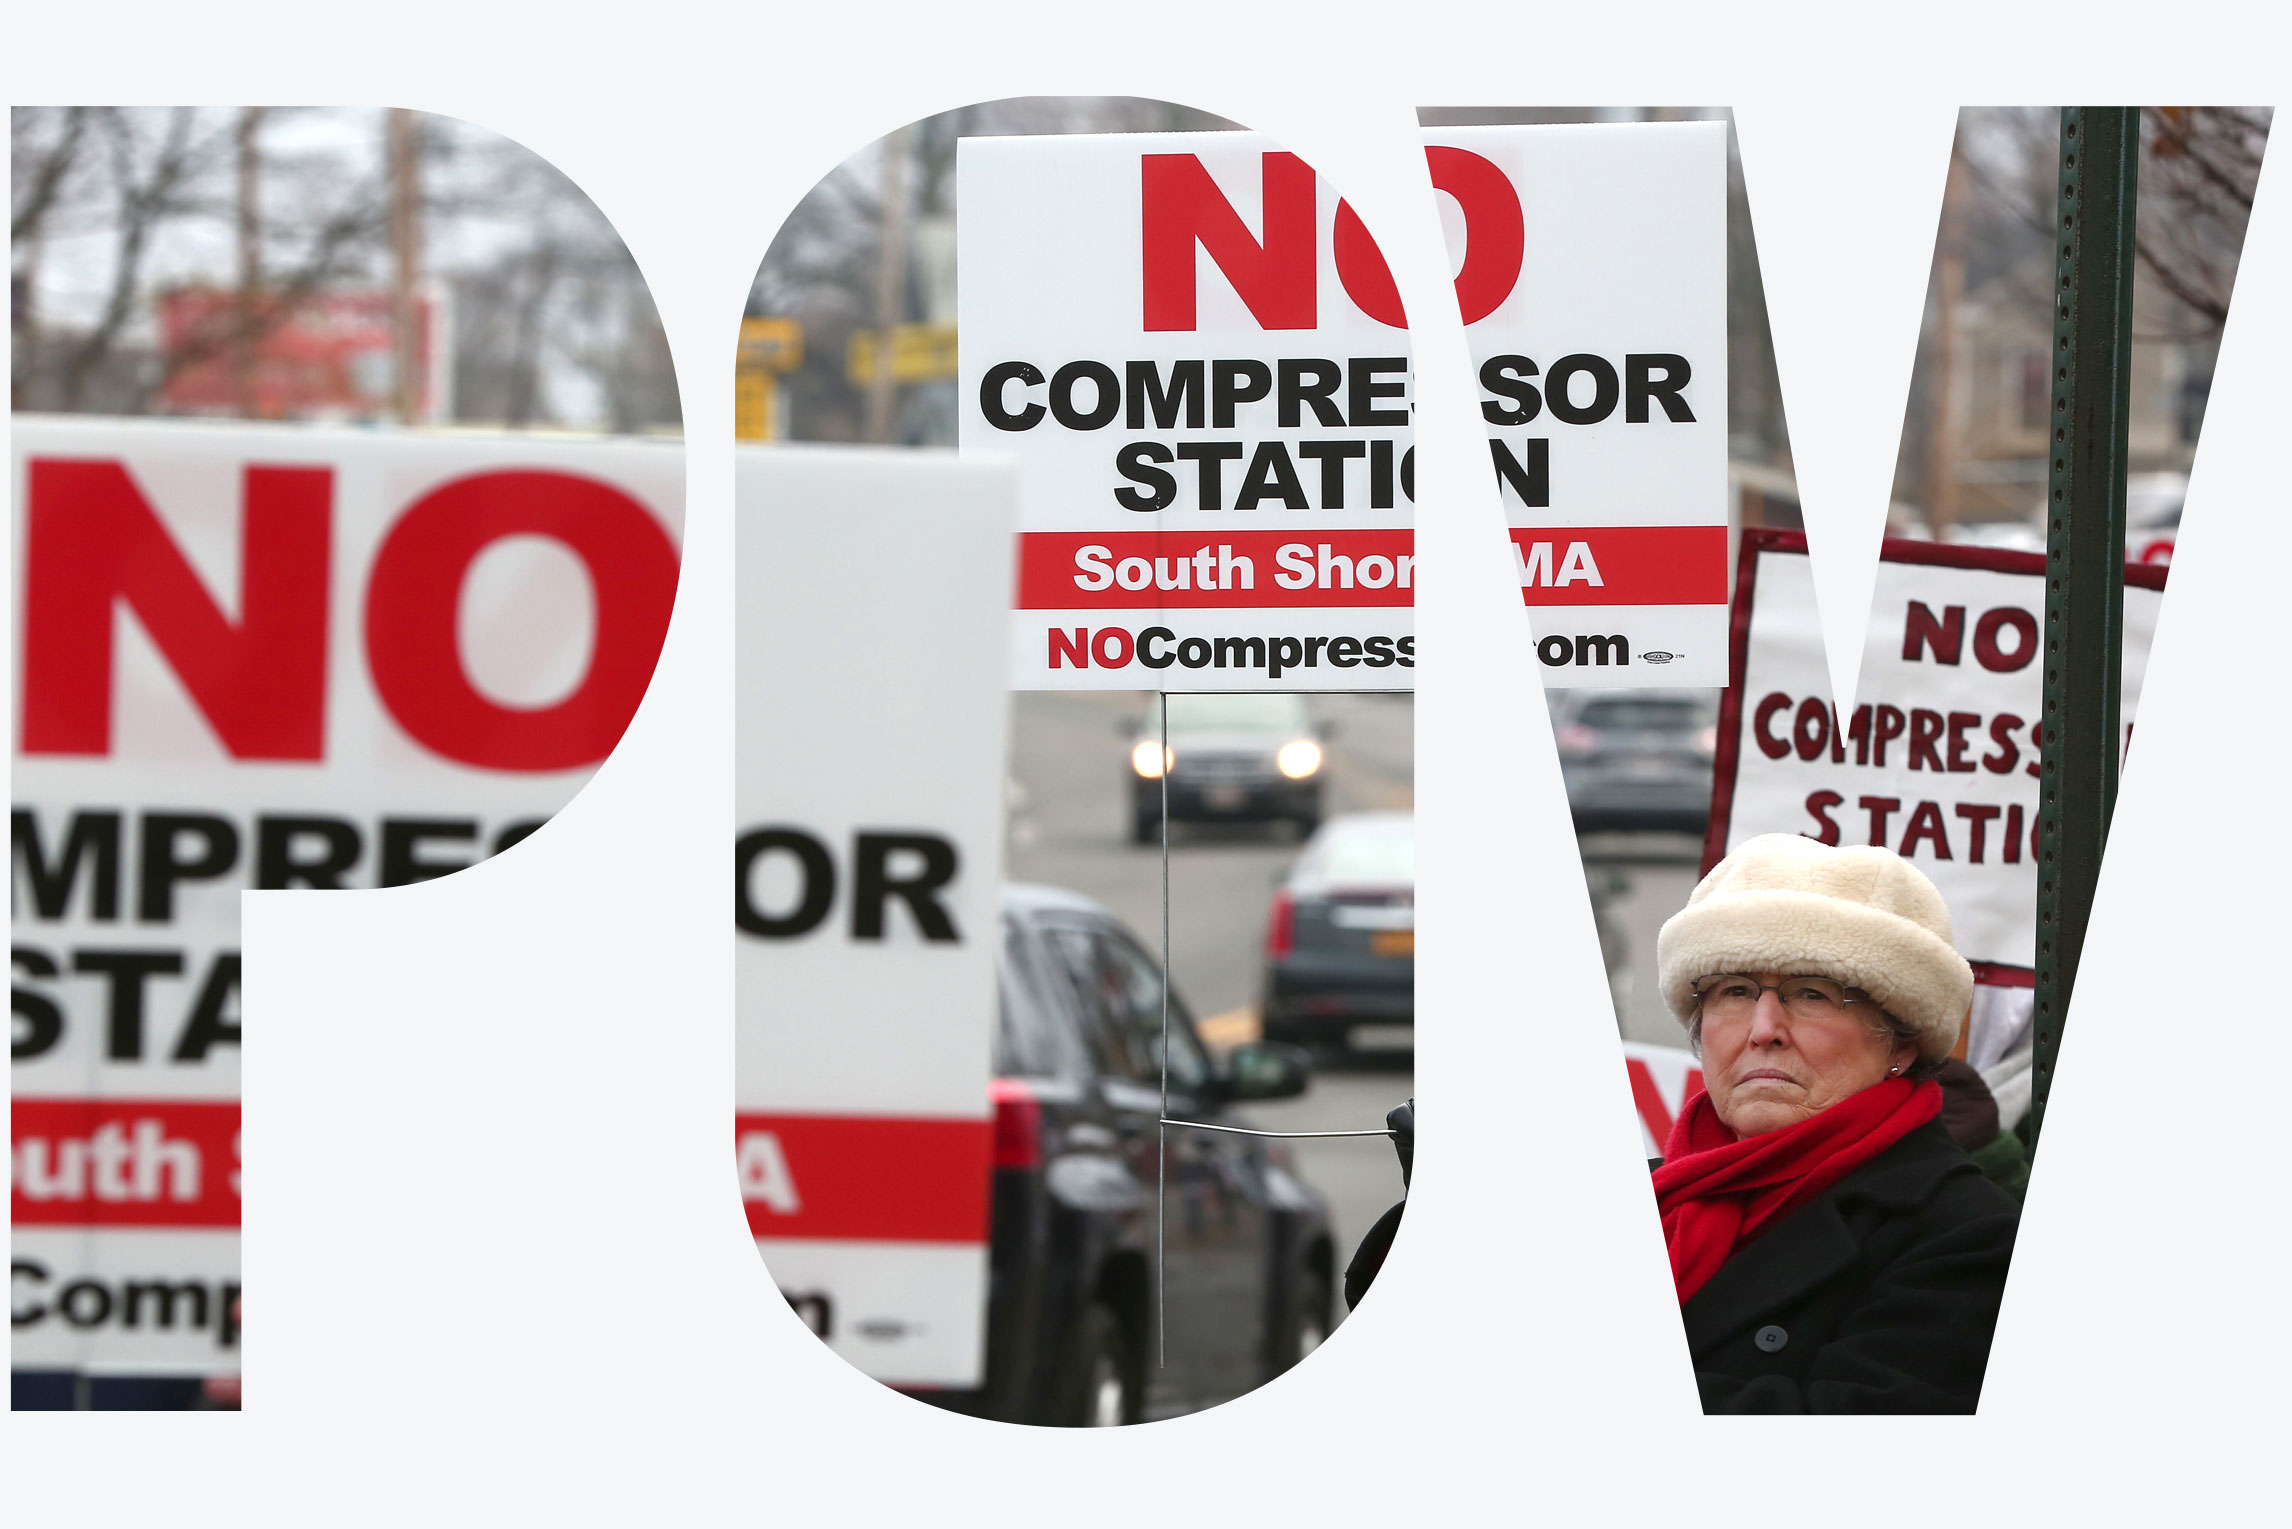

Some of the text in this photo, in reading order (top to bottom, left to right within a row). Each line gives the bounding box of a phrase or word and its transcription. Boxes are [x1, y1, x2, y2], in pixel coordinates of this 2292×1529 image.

[1141, 146, 1525, 332] NO
[979, 353, 1697, 431] COMPRESOR
[1113, 438, 1549, 512] STATIN
[1073, 541, 1605, 592] South Shor MA
[20, 456, 685, 773] NO
[1902, 600, 2038, 673] NO
[1800, 790, 2040, 864] STATI
